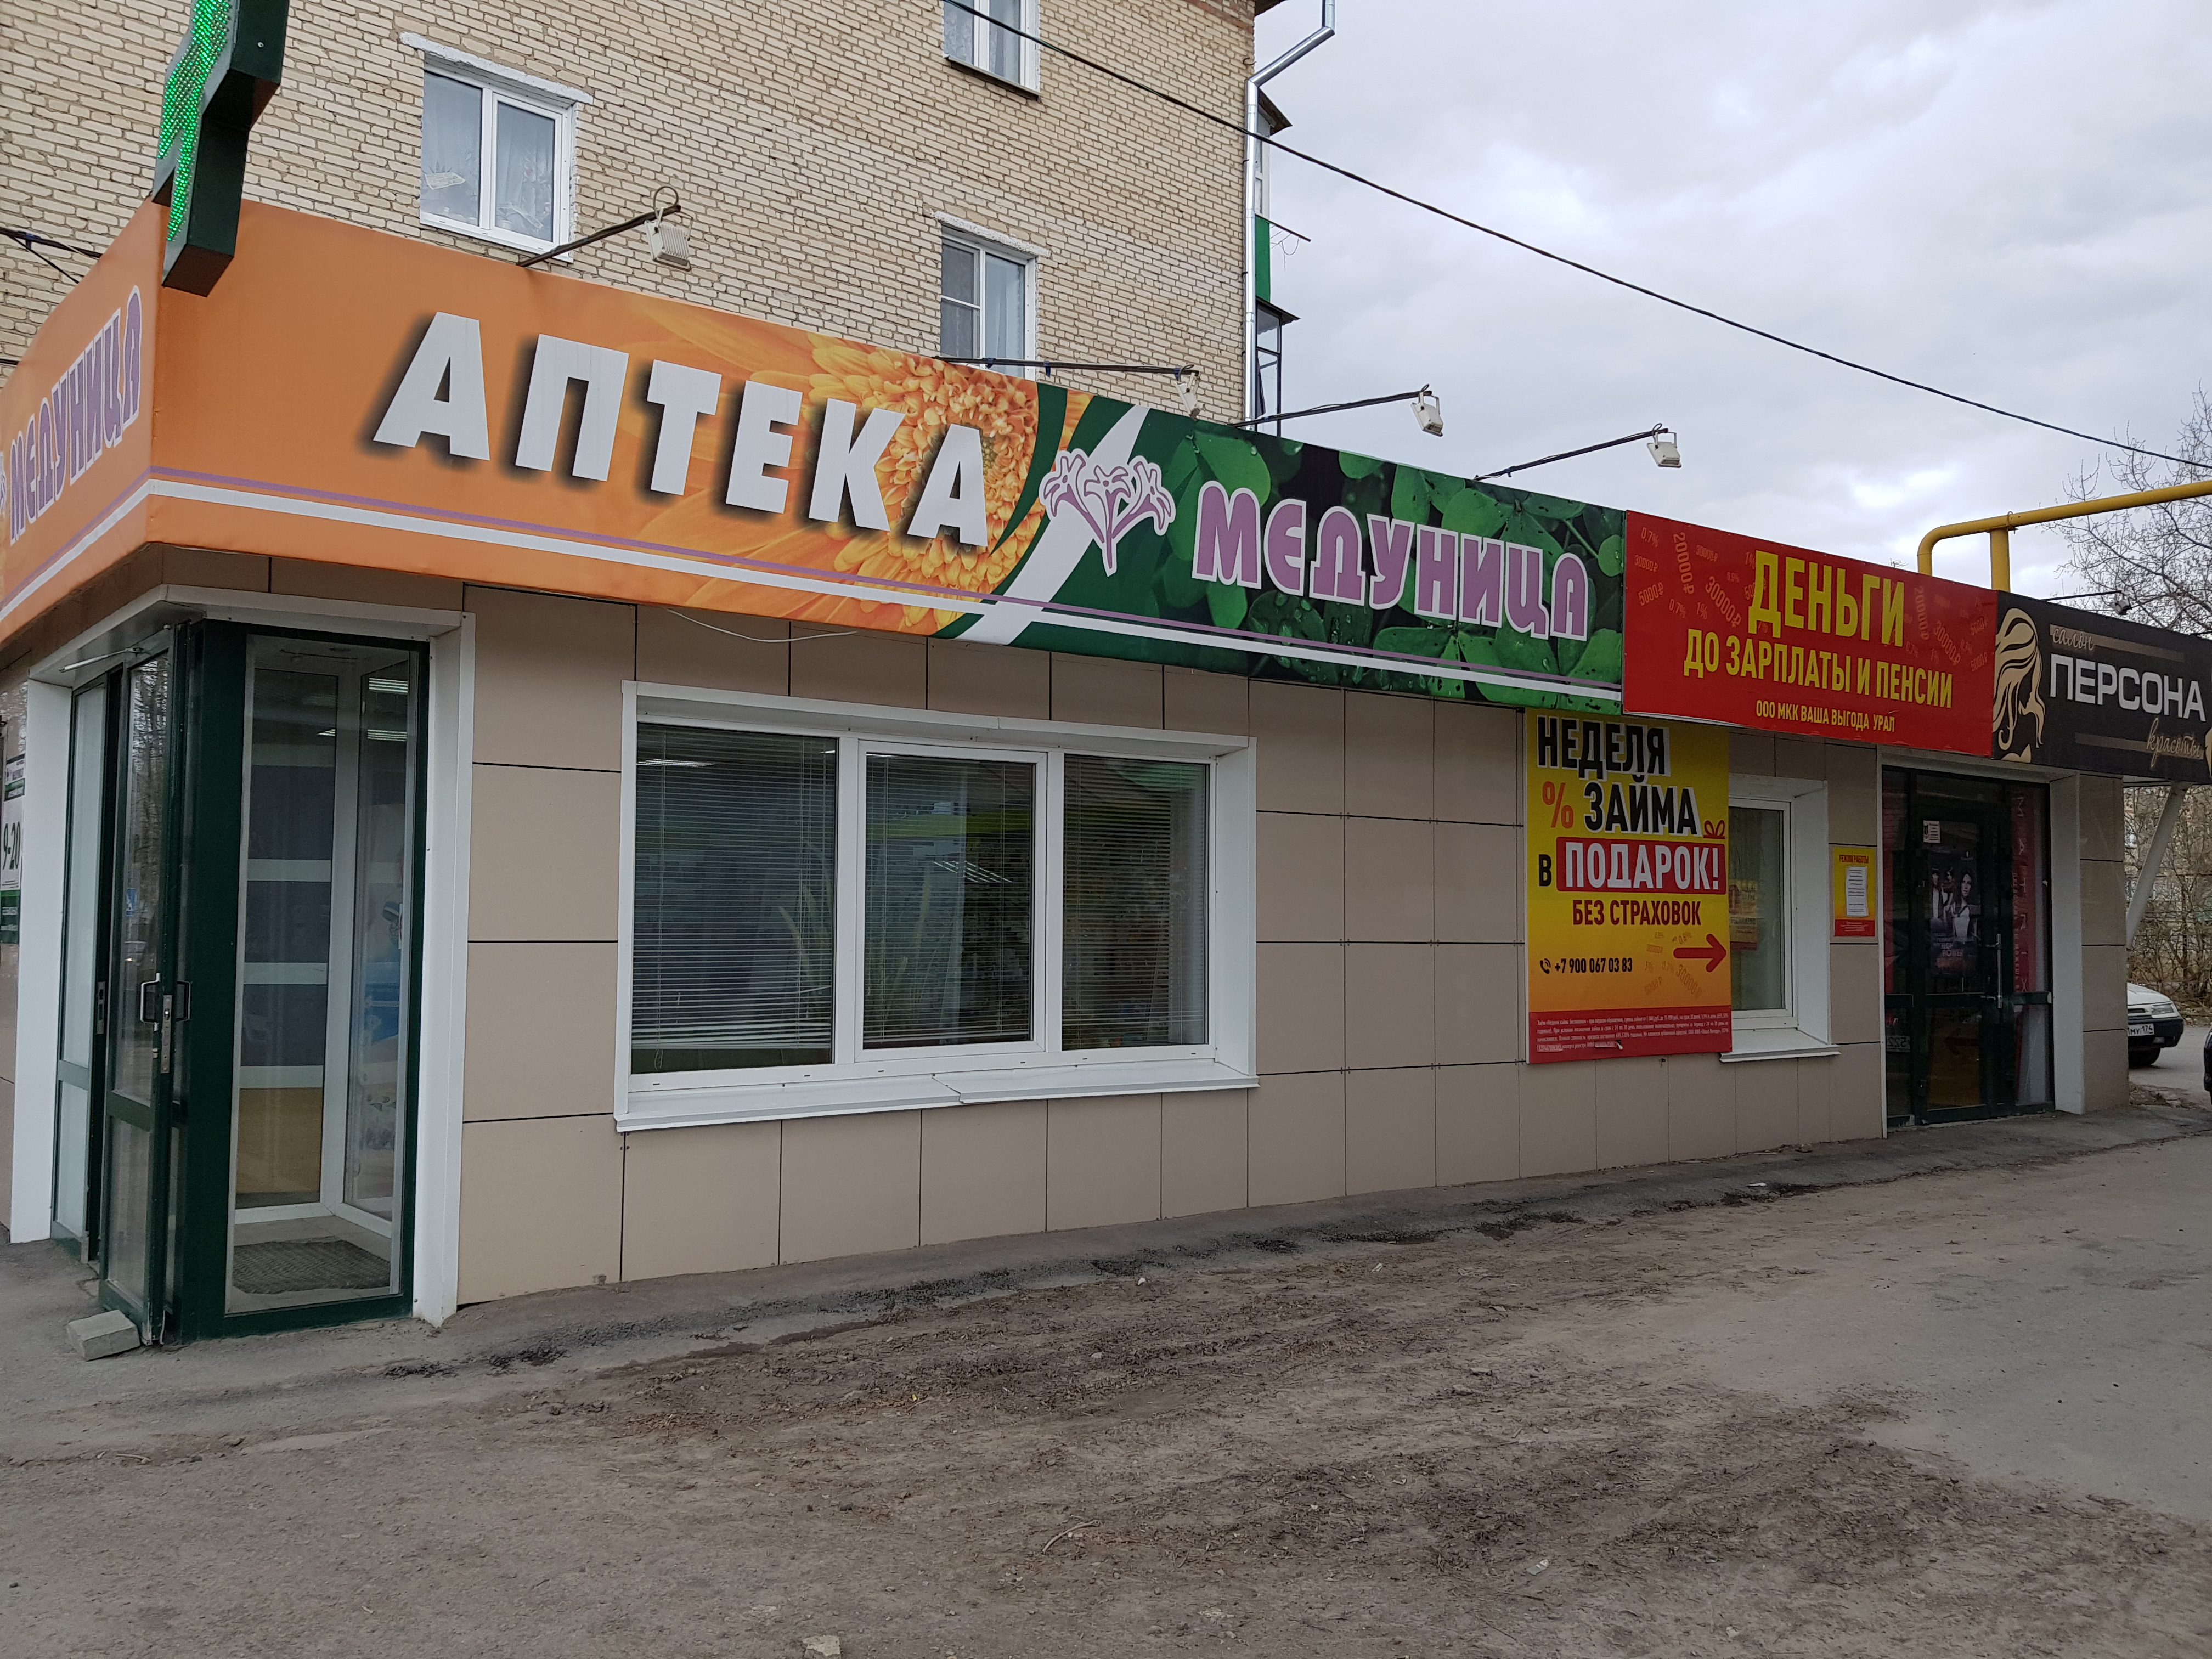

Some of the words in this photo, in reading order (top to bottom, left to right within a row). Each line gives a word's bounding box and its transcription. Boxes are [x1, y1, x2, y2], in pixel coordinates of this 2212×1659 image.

[10, 285, 143, 546] МЕДУНИЦА
[373, 311, 988, 548] АПТЕКА
[1192, 480, 1588, 641] МЕДУНИЦА
[1641, 527, 1659, 547] 0.7%
[1748, 550, 1904, 647] ДЕНЬГИ
[1683, 628, 1720, 679] ДО
[1725, 635, 1850, 694] ЗАРПЛАТЫ
[1857, 658, 1870, 696] И
[1876, 661, 1953, 709] ПЕНСИИ
[2050, 653, 2207, 722] ПЕРСОНА
[1537, 715, 1671, 781] НЕДЕЛЯ
[1756, 699, 1776, 719] ООО
[1778, 702, 1799, 721] МКК
[1801, 705, 1830, 725] ВАША
[1831, 709, 1870, 732] ВЫГОДА
[1873, 714, 1895, 733] УРАЛ
[1584, 774, 1701, 836] ЗАЙМА
[3, 821, 21, 870] 9-20
[1565, 841, 1719, 890] ПОДАРОК!
[1572, 899, 1605, 926] БЕЗ
[1610, 899, 1702, 926] СТРАХОВОК
[1555, 958, 1566, 974] +7
[1569, 958, 1587, 973] 900
[1589, 957, 1606, 973] 067
[1608, 957, 1620, 973] 03
[1622, 957, 1633, 972] 83
